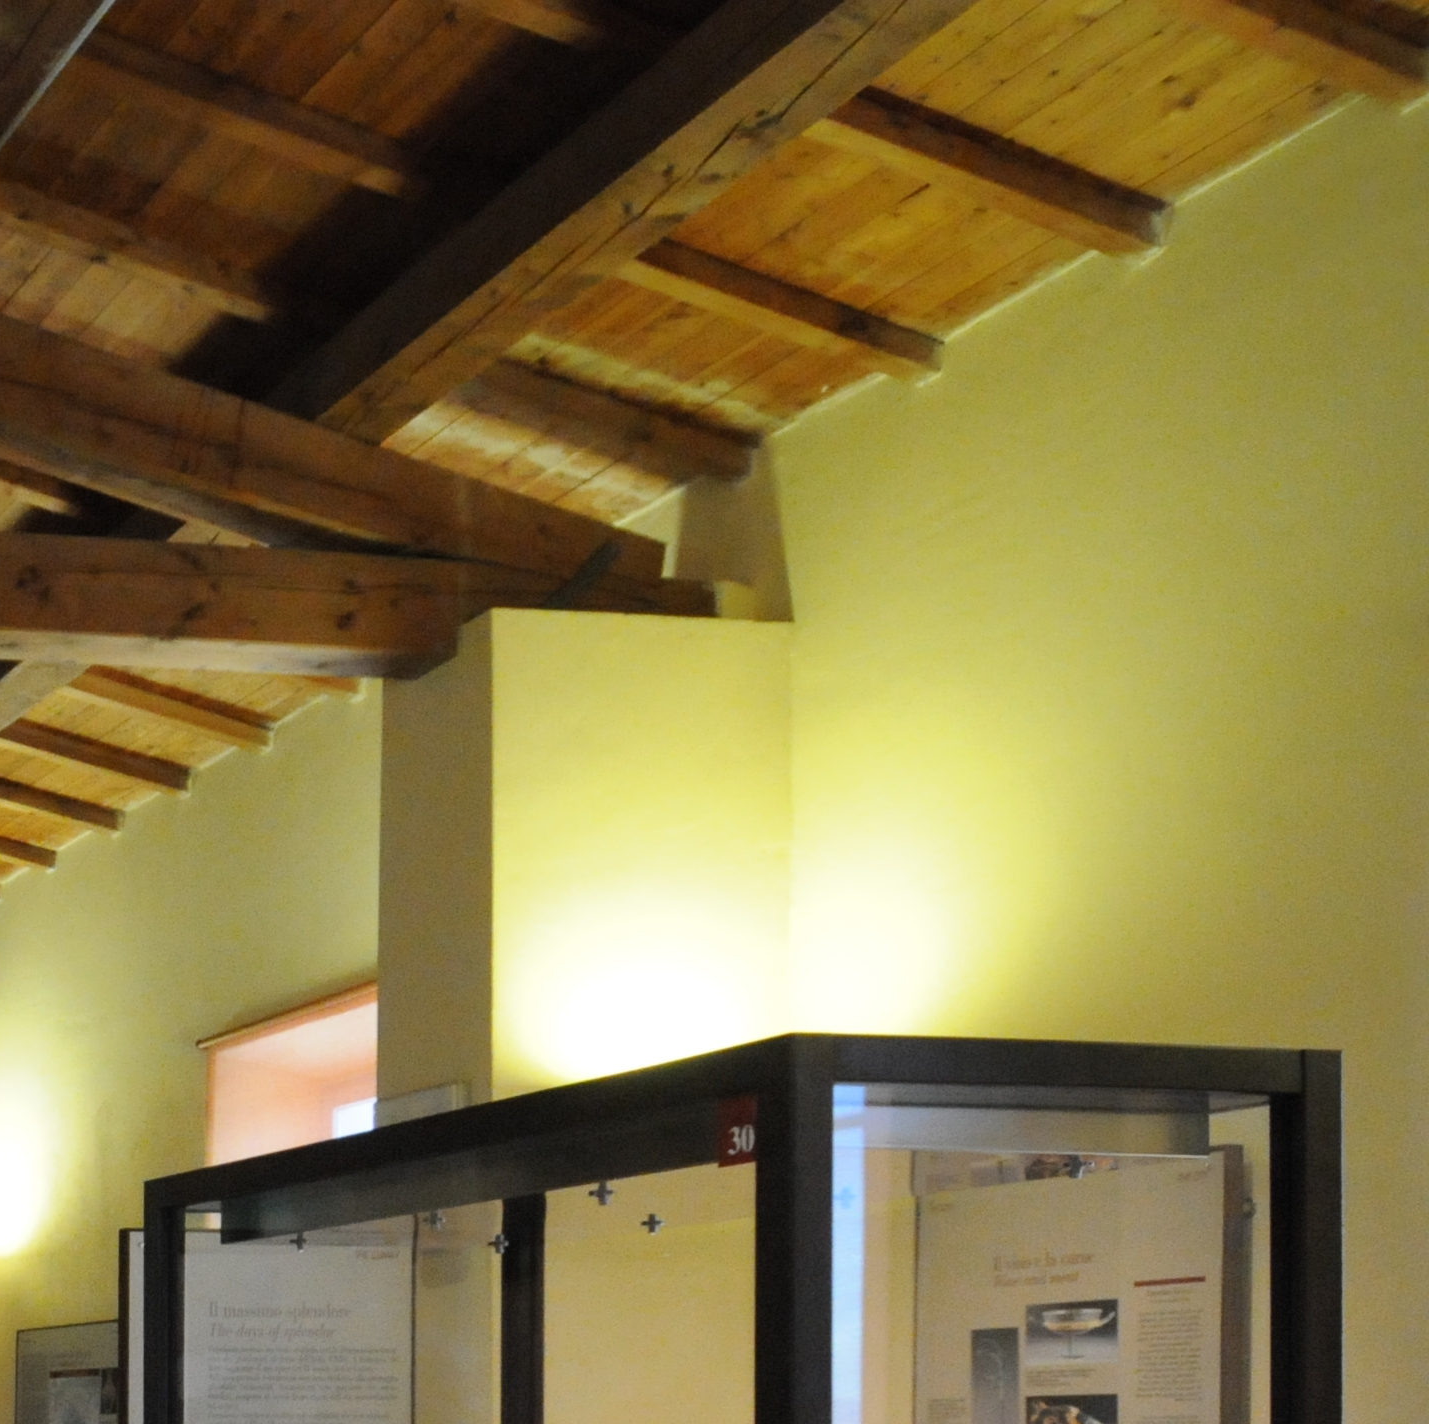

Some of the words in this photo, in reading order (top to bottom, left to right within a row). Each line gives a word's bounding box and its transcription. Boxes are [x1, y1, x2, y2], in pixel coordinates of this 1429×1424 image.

[727, 1125, 756, 1155] 30
[209, 1300, 219, 1318] Il
[223, 1305, 283, 1319] massimo
[286, 1300, 352, 1323] splendore
[210, 1322, 233, 1338] The
[236, 1323, 264, 1338] days
[267, 1323, 282, 1342] of
